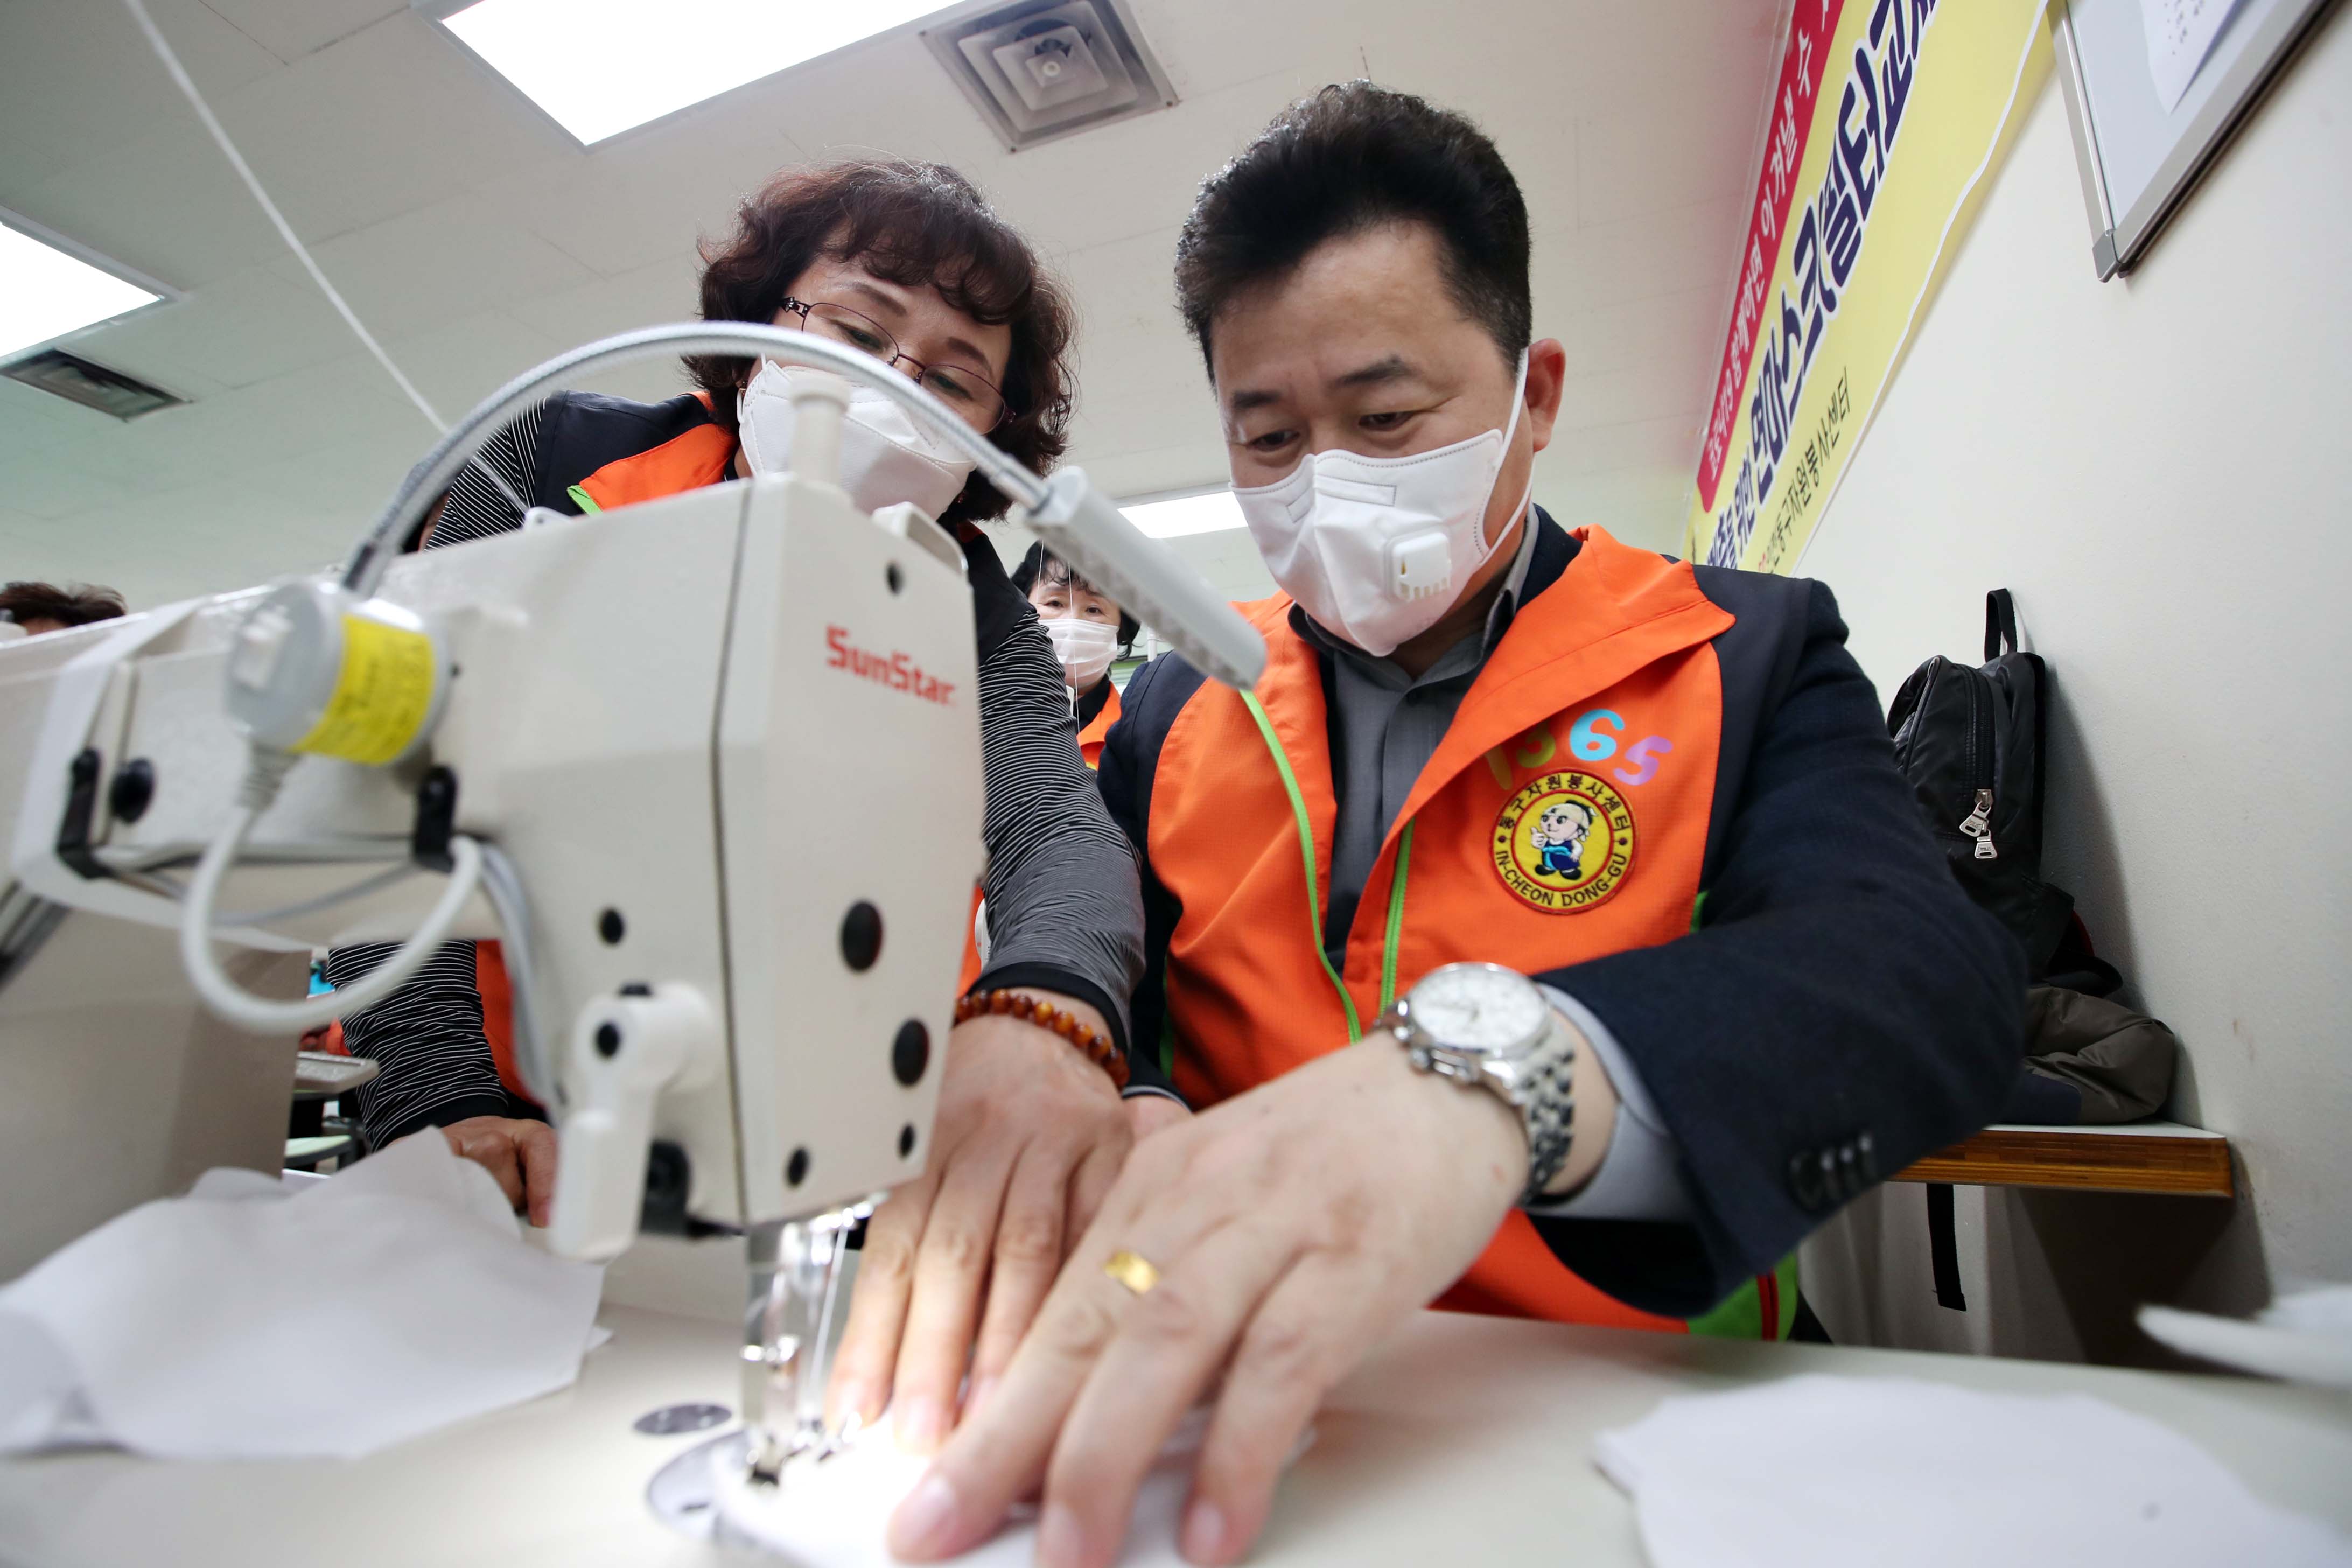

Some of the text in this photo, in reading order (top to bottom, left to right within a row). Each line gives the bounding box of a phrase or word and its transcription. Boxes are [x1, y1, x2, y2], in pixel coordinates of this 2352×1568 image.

[1731, 234, 1764, 389] 함께하면
[1761, 82, 1798, 240] 이겨낼
[1798, 27, 1812, 99] 수
[1734, 442, 1756, 558] 위한
[825, 624, 955, 705] SunStar
[1499, 774, 1632, 831] 동구자원봉사센터
[1495, 850, 1627, 907] IN-CHEON DONG-GU
